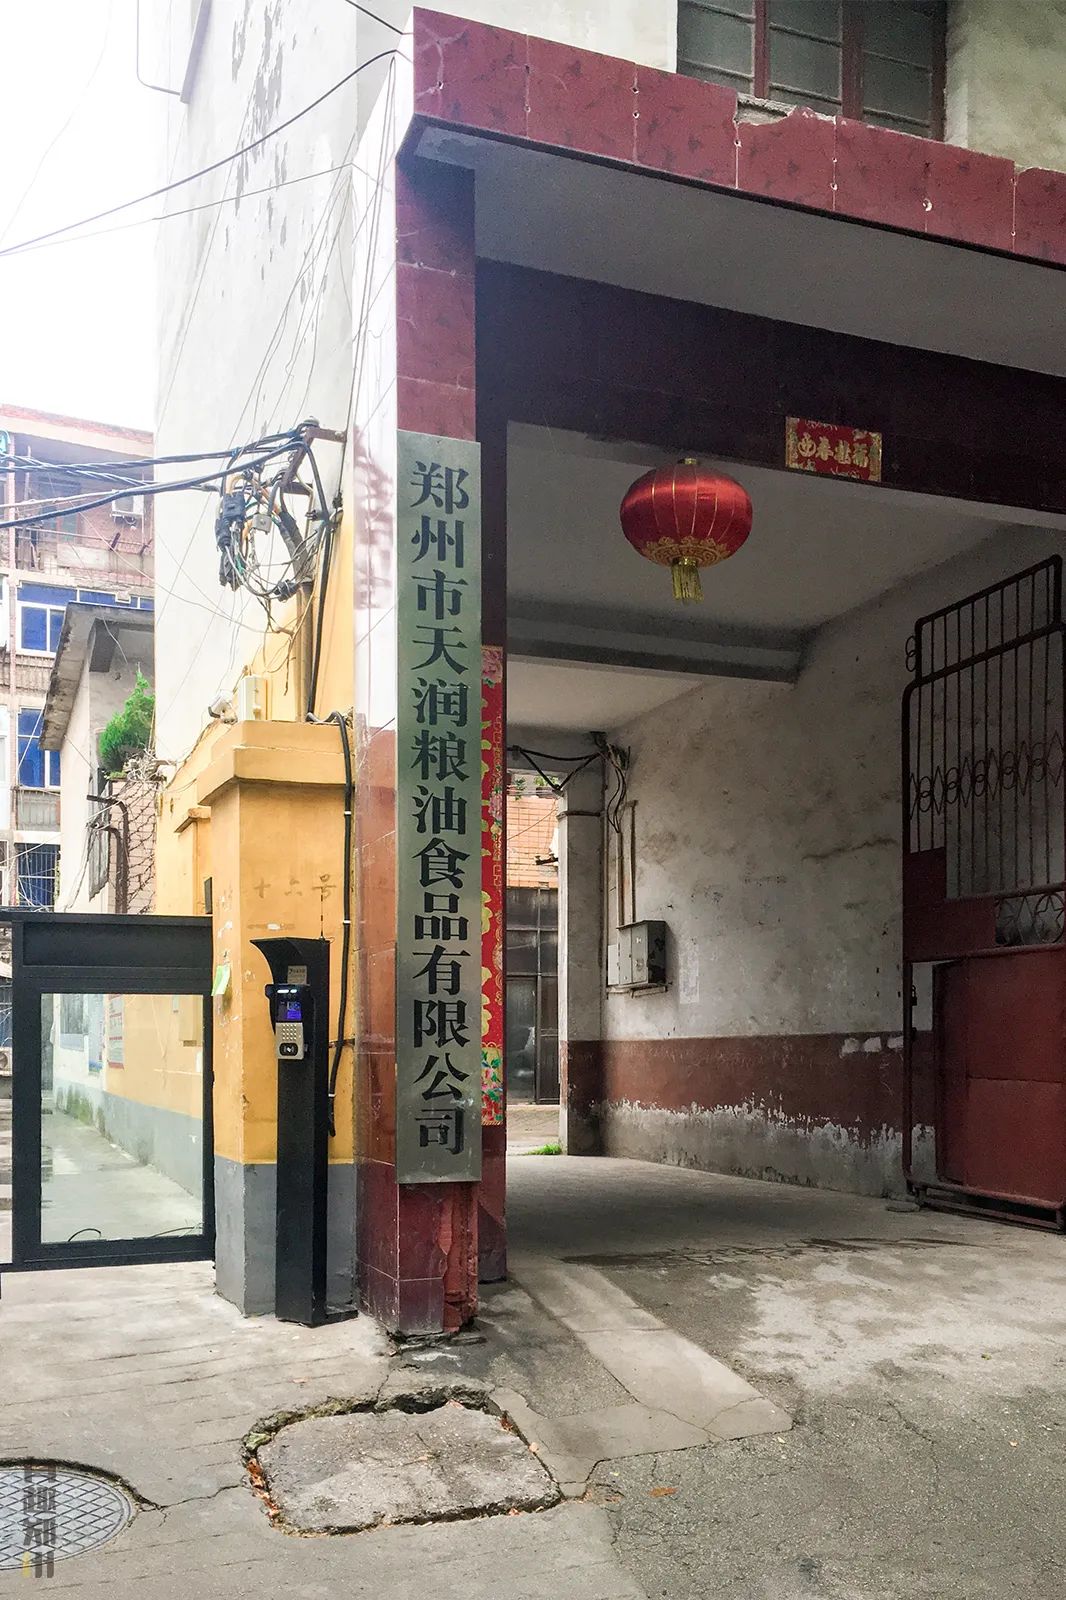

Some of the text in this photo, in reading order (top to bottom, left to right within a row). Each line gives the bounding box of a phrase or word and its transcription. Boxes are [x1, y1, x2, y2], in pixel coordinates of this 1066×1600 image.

[411, 461, 469, 1154] 郑州市天润粮油食品有限公司
